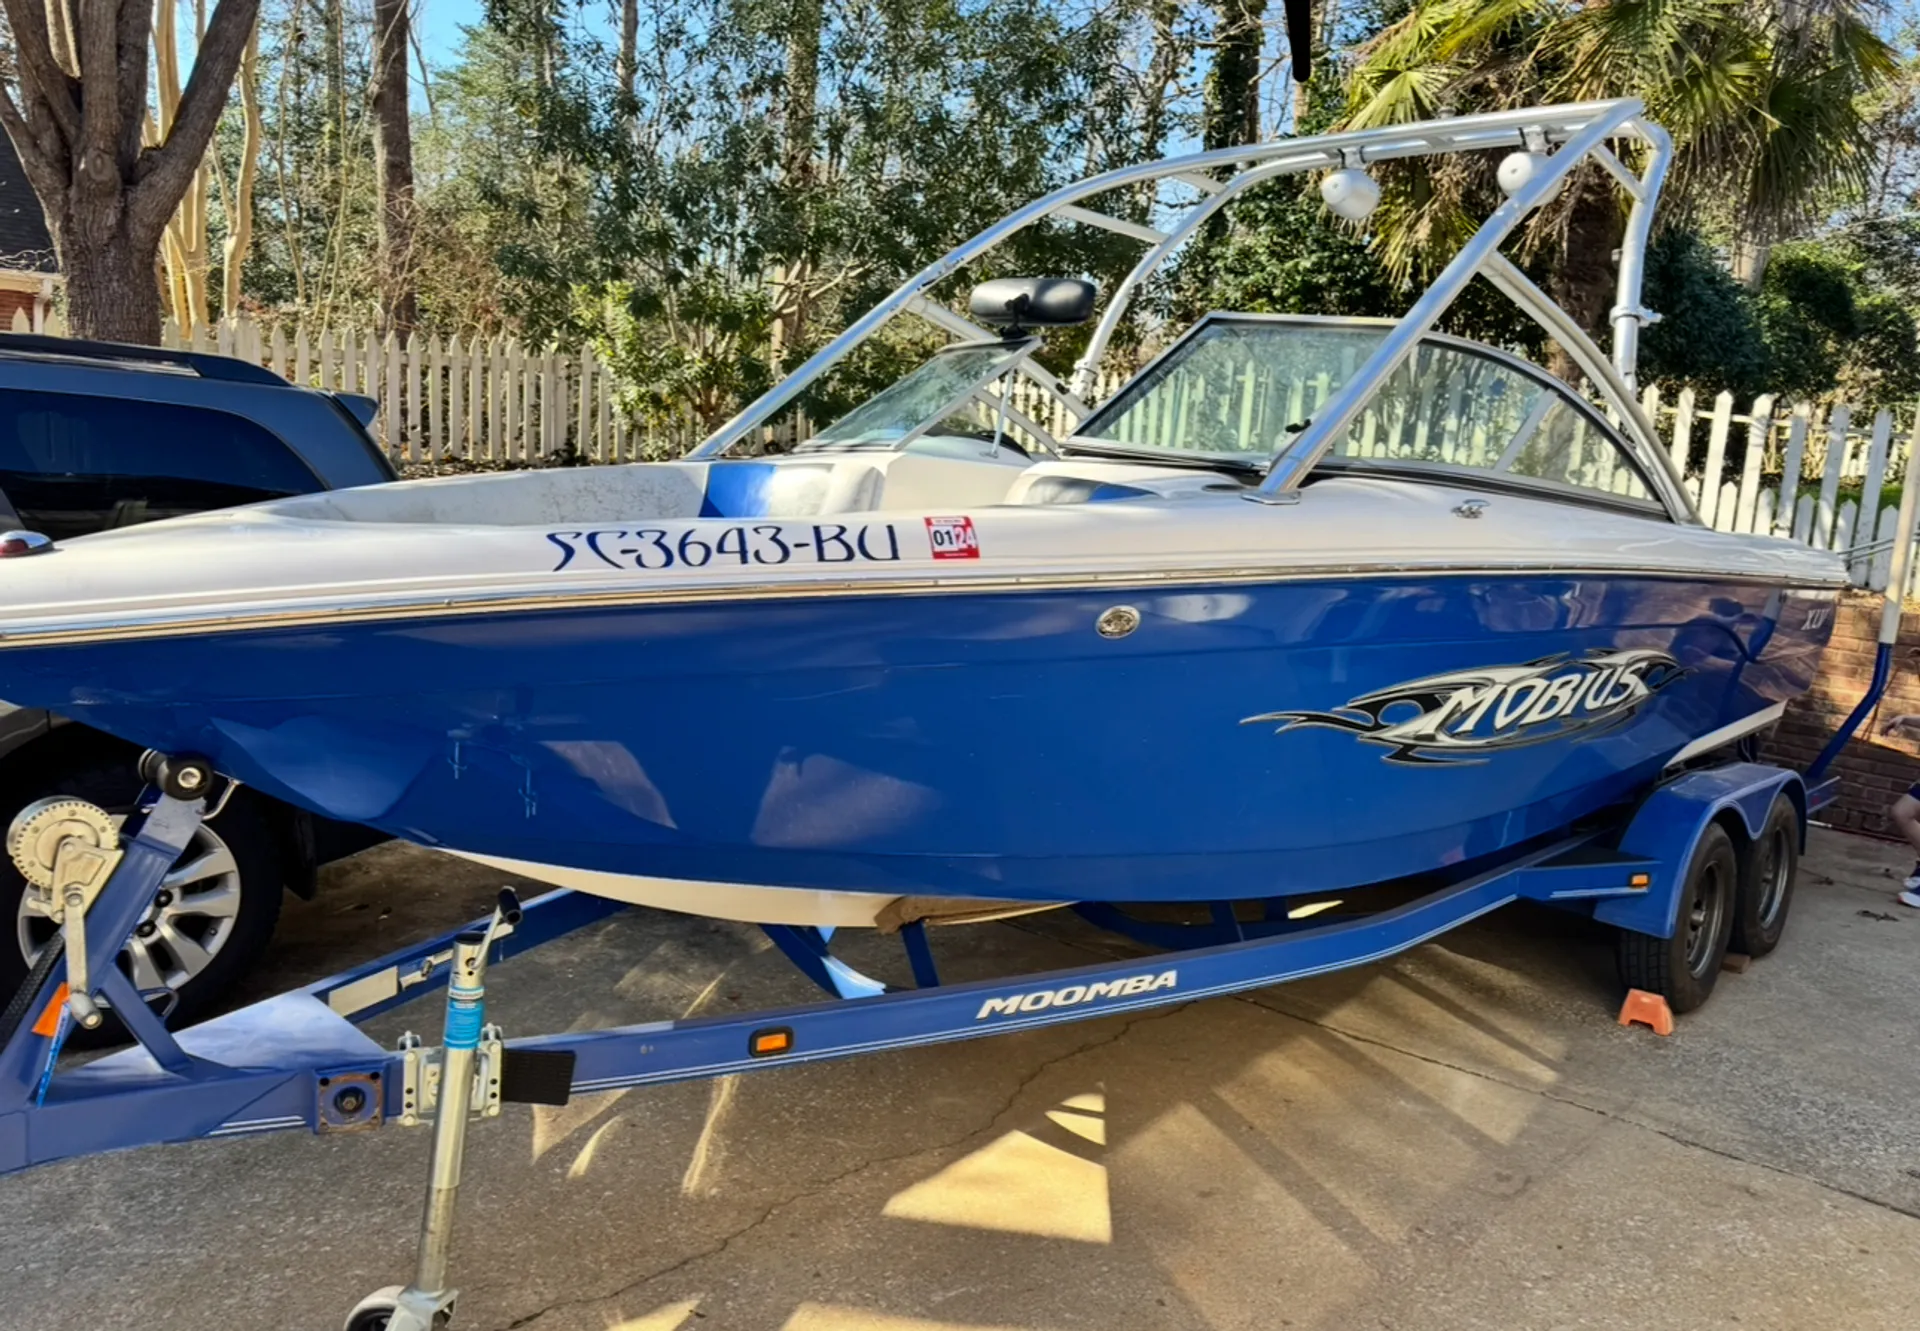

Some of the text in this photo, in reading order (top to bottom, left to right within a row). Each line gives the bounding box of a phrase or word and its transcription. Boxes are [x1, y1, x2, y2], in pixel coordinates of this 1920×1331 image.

[546, 523, 900, 572] SC-3643-BU
[933, 529, 954, 546] 01
[1412, 660, 1651, 737] MOBIUS
[975, 969, 1178, 1020] MOOMBA
